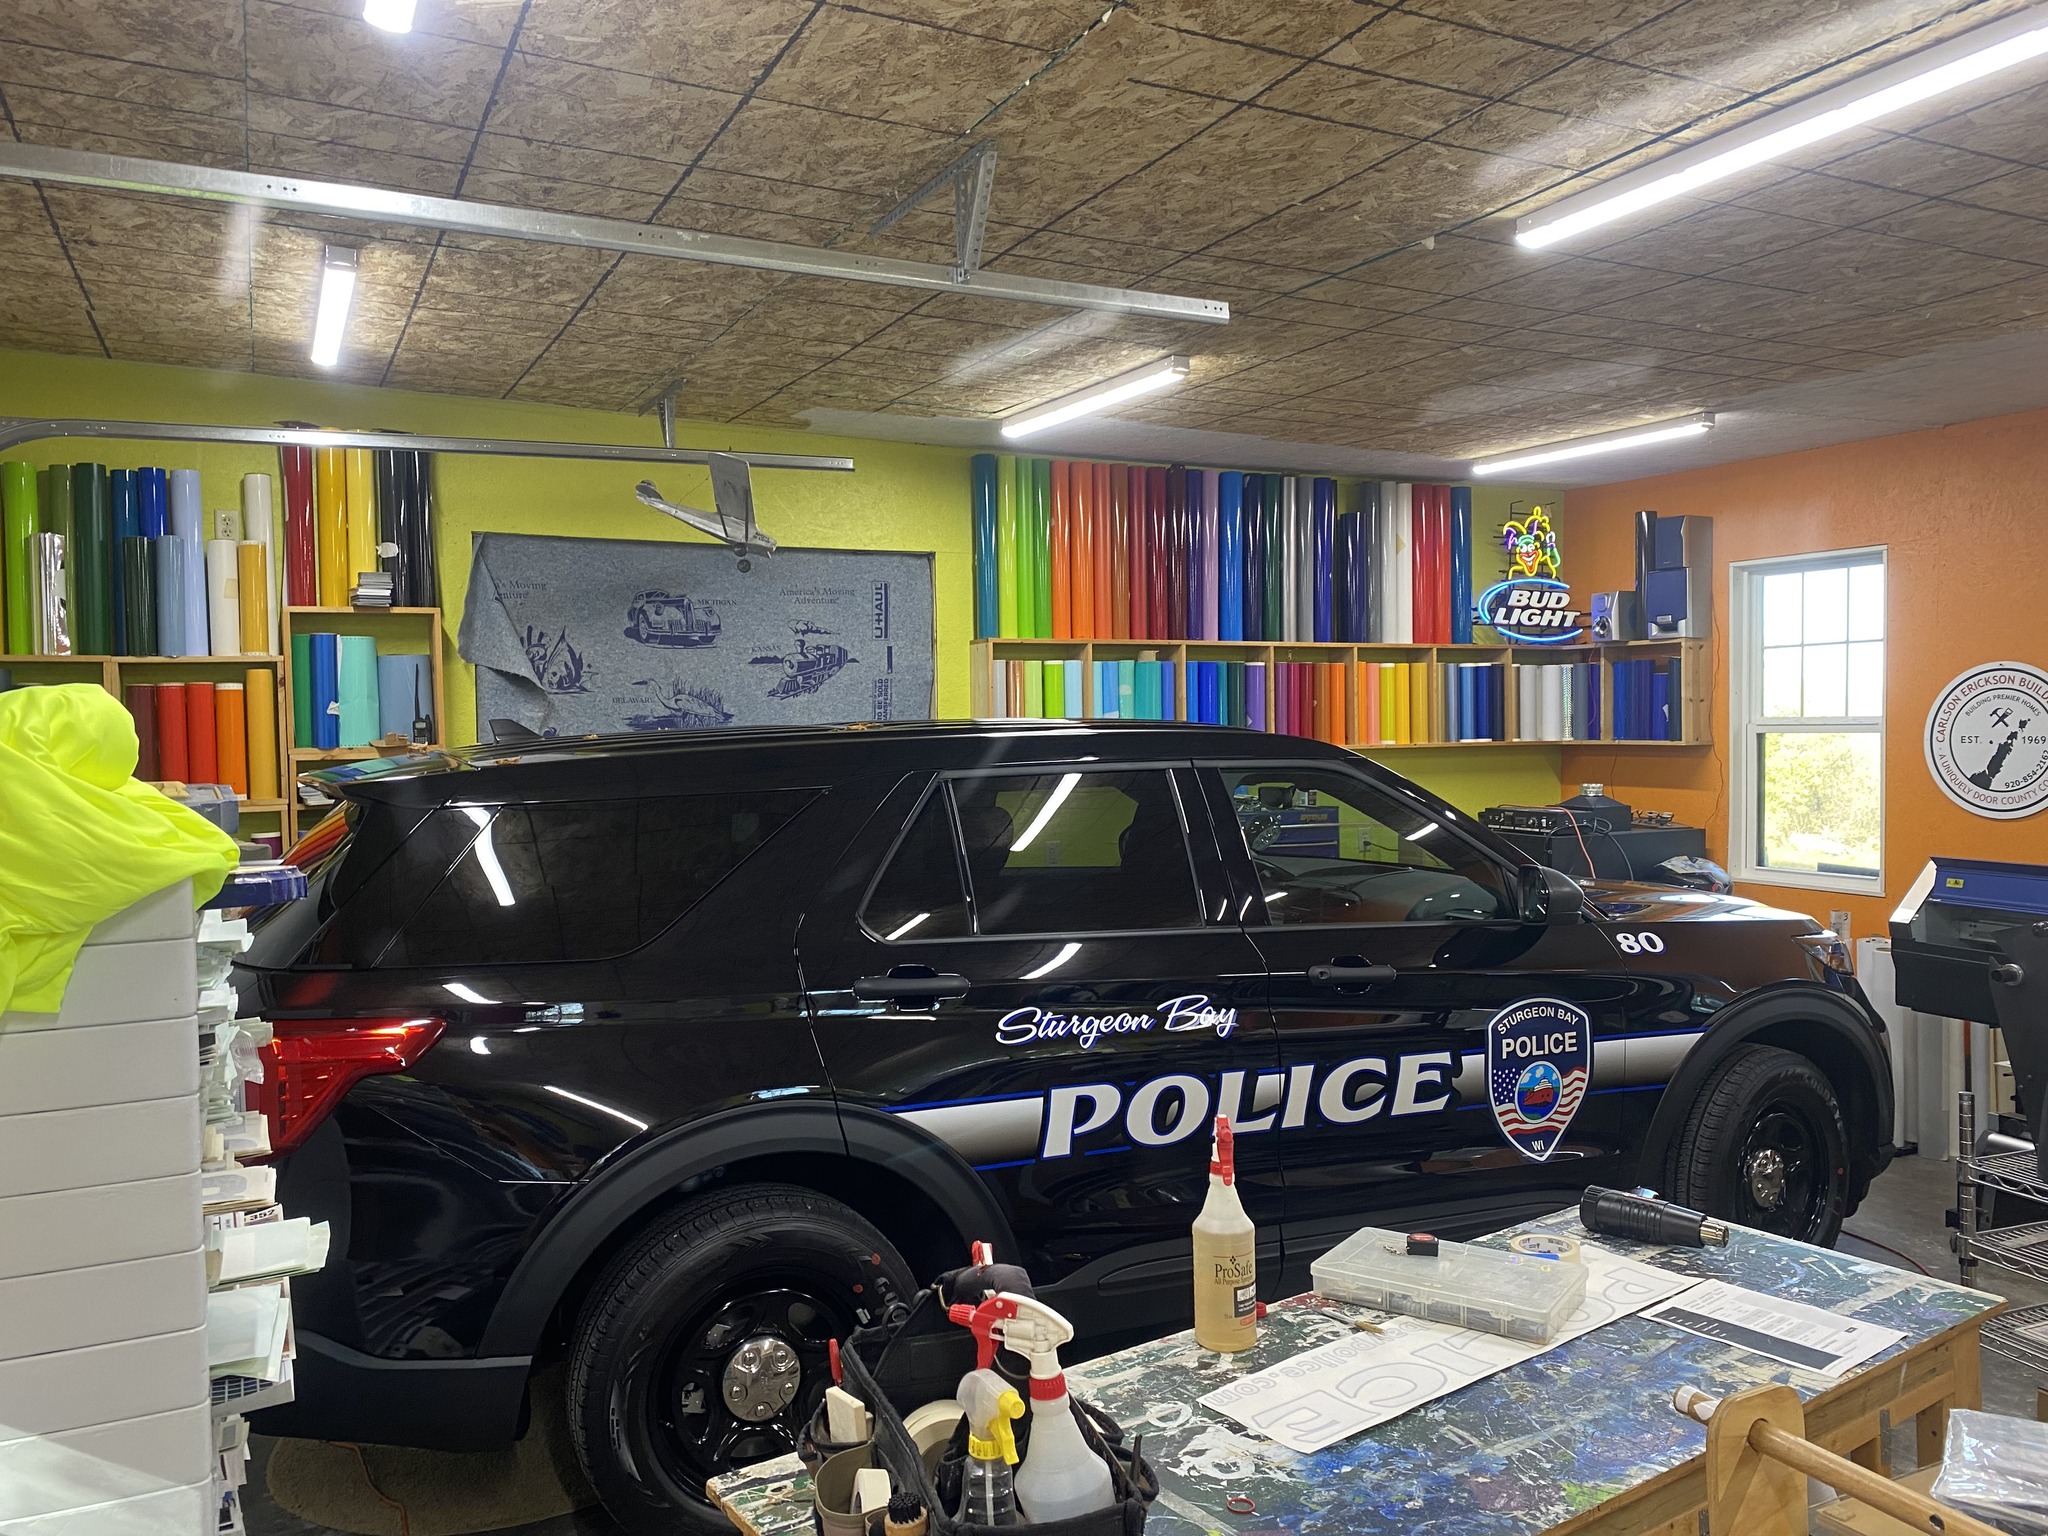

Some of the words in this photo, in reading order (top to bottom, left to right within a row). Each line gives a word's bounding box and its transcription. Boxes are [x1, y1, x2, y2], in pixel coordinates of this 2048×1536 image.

[509, 580, 547, 591] Moving
[779, 587, 822, 597] America's
[822, 587, 855, 597] Moving
[1507, 589, 1571, 609] BUD
[1493, 607, 1581, 627] LIGHT
[1936, 694, 1962, 743] CARLSON
[1960, 674, 2016, 697] ERICKSON
[2019, 677, 2048, 704] BUILD
[1965, 696, 1992, 716] BUILDING
[1992, 694, 2020, 702] PREMIER
[2021, 700, 2042, 716] HOMES
[1960, 735, 1982, 744] EST.
[2021, 735, 2047, 745] 1969
[1941, 759, 1973, 795] UNIQUELY
[1972, 791, 1998, 805] DOOR
[2001, 788, 2038, 805] COUNTY
[1616, 931, 1665, 954] 80
[995, 1006, 1155, 1050] Sturgeon
[1156, 994, 1239, 1039] Bay
[1497, 1006, 1556, 1035] STURGEON
[1557, 1008, 1579, 1026] BAY
[1501, 1031, 1578, 1060] POLICE
[1041, 1050, 1453, 1159] POLICE
[1531, 1139, 1545, 1151] WI
[1215, 1260, 1253, 1279] ProSafe
